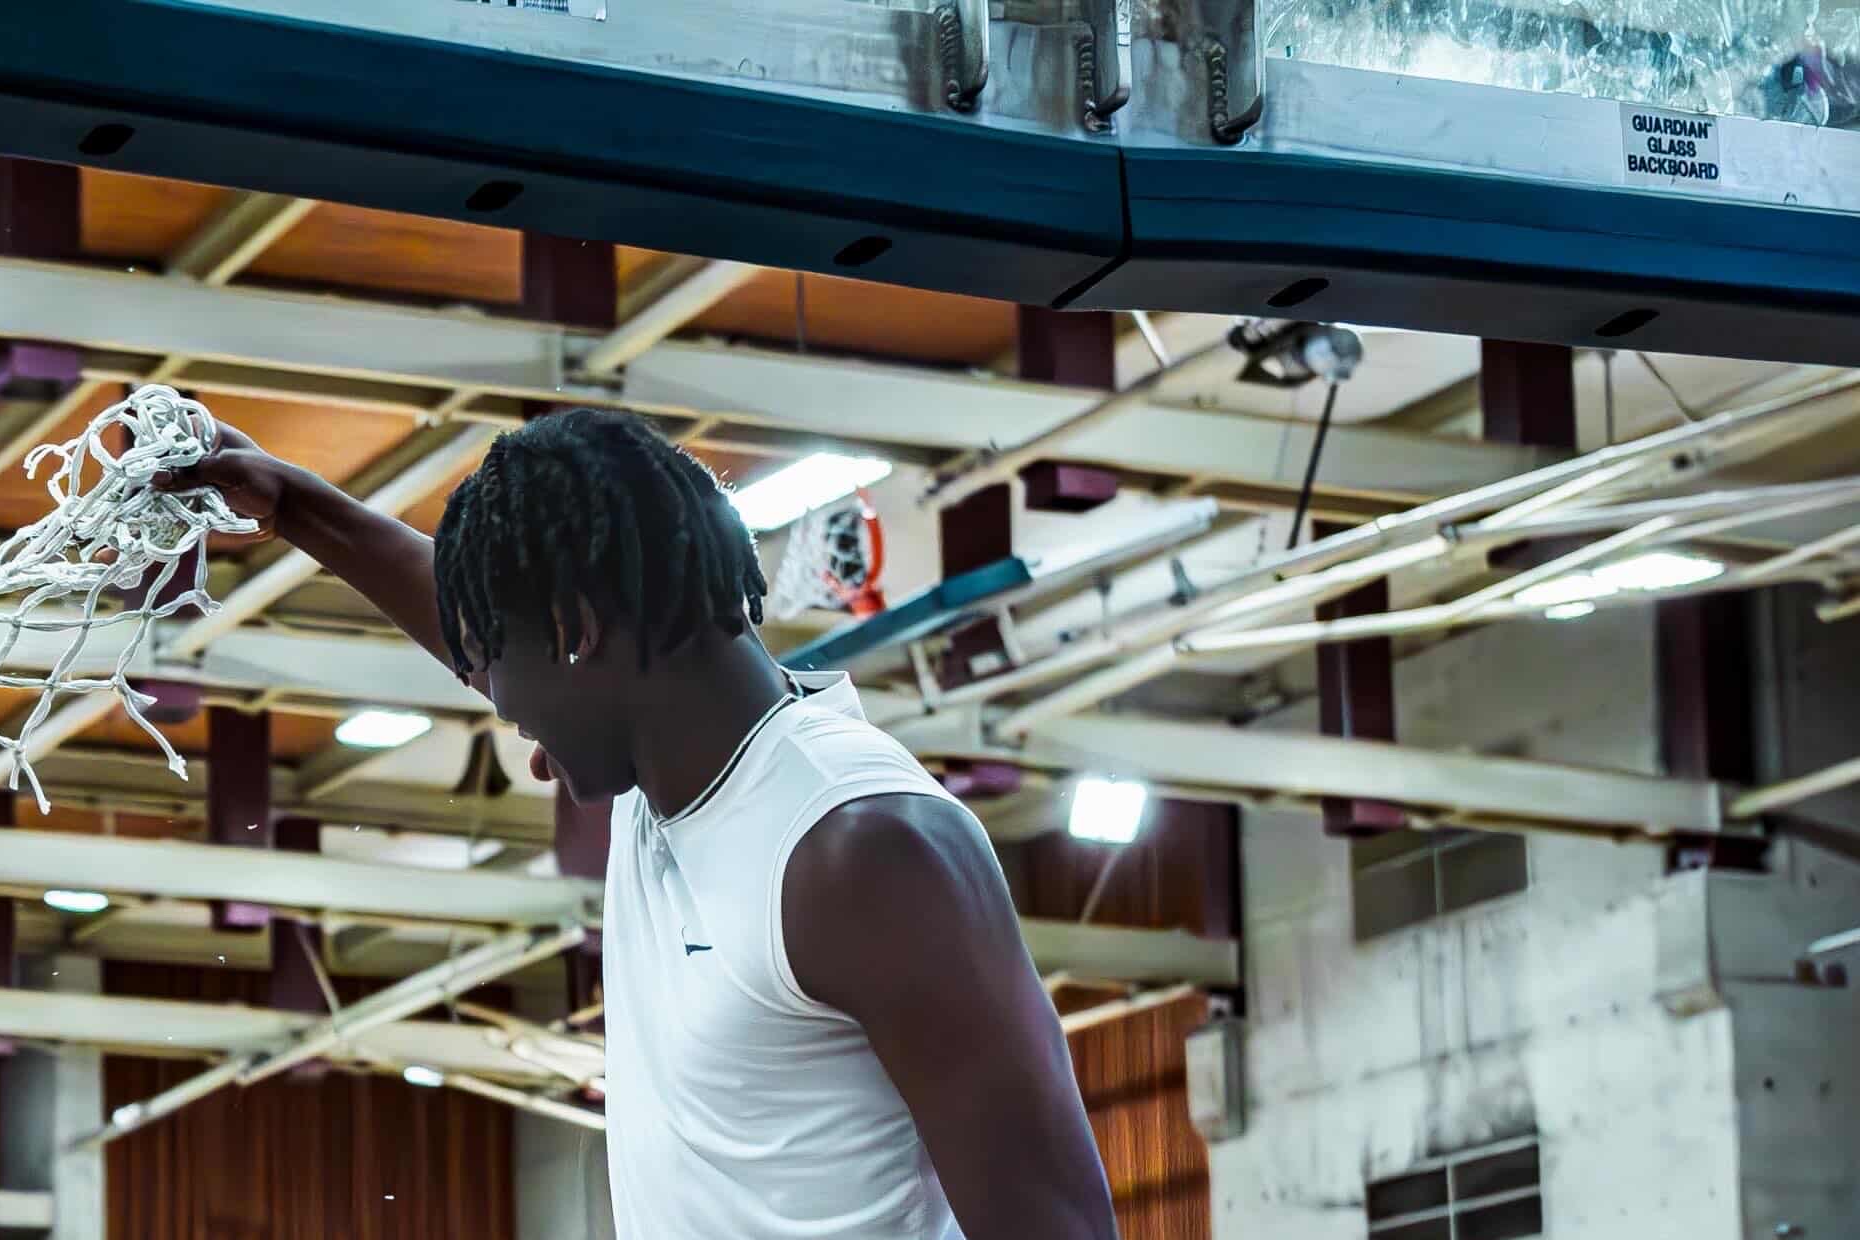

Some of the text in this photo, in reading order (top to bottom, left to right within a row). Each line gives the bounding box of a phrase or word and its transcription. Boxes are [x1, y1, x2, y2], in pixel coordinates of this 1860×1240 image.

[1632, 115, 1709, 139] GUARDIAN
[1647, 136, 1697, 158] GLASS
[1627, 154, 1719, 180] BACKBOARD
